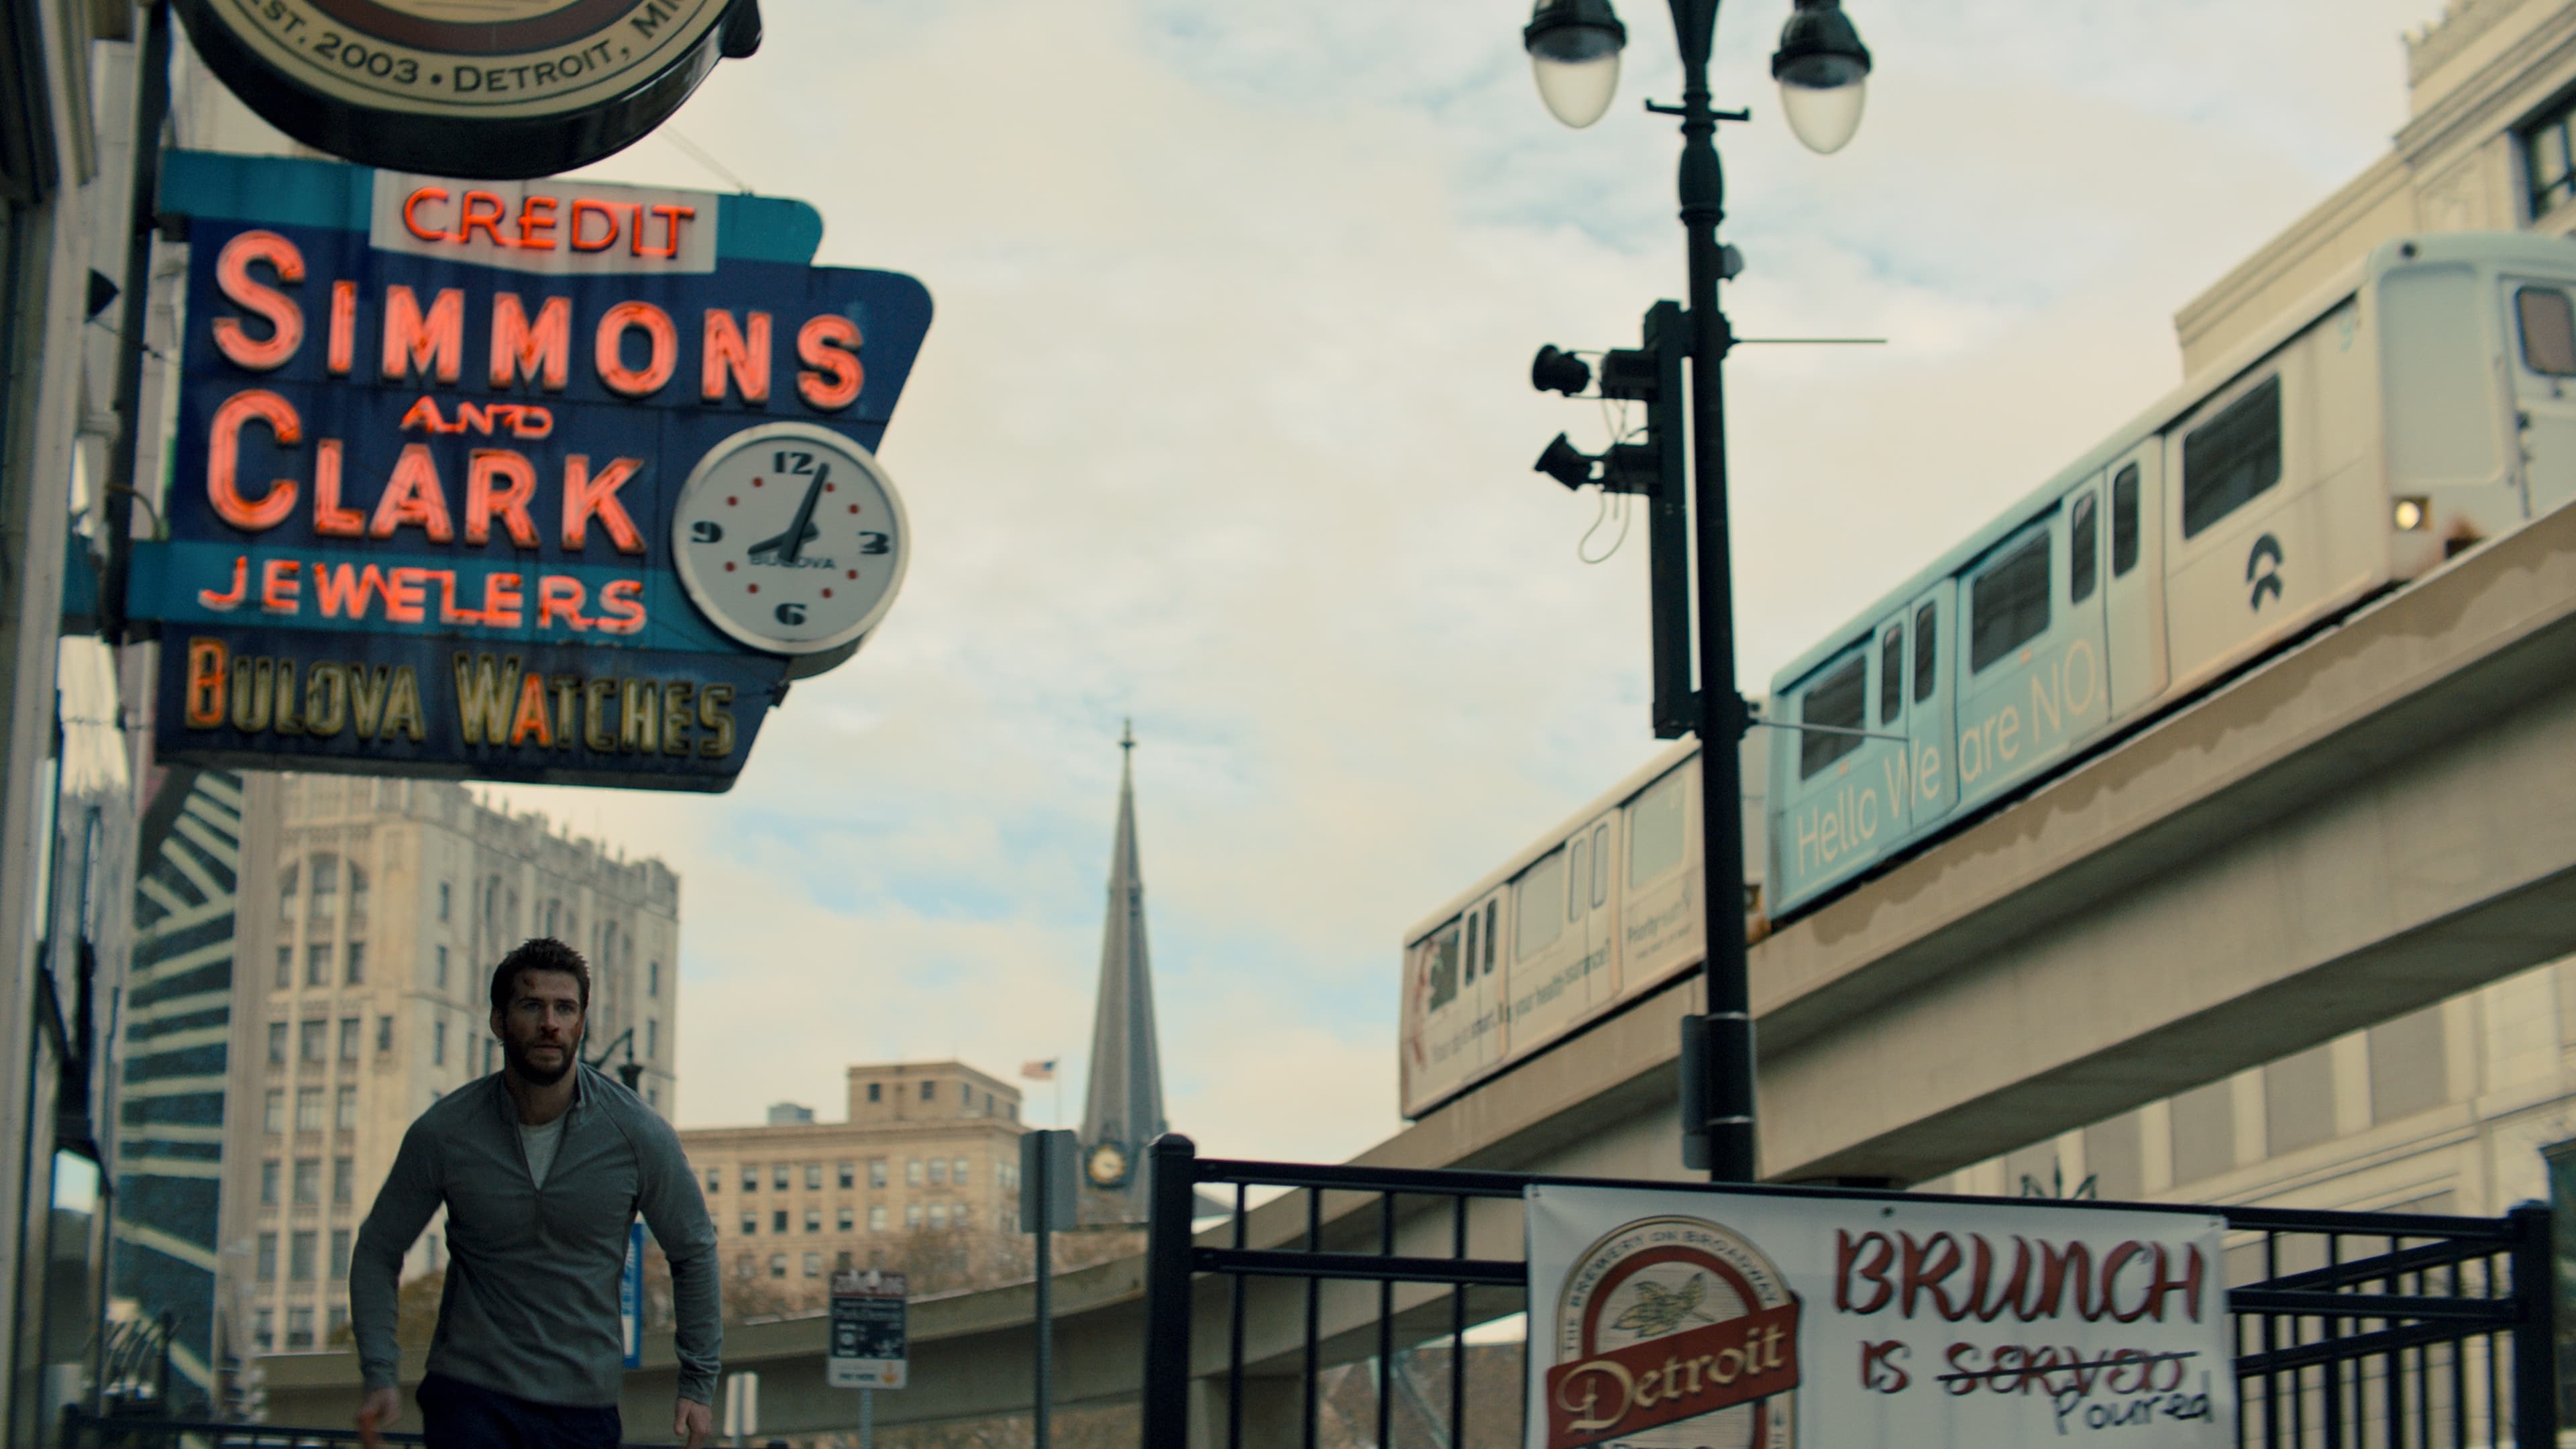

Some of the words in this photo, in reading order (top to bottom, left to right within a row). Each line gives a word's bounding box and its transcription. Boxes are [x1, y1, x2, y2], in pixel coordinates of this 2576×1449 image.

[252, 0, 307, 44] ST.
[313, 32, 420, 85] 2003
[402, 186, 696, 260] CREDIT
[211, 229, 865, 410] SIMMONS
[398, 394, 554, 440] AND
[207, 389, 647, 554] CLARK
[773, 451, 814, 476] 12
[690, 521, 723, 544] 9
[858, 531, 891, 555] 3
[199, 555, 647, 635] JEWELERS
[773, 602, 808, 626] 6
[185, 636, 426, 741] BULOVA
[453, 651, 737, 758] WATCHES
[1796, 782, 1878, 877] Hello
[1883, 736, 1940, 819] We
[1957, 703, 2021, 783] are
[1835, 1228, 2204, 1324] BRUNCH
[1556, 1324, 1786, 1434] Detroit
[1861, 1340, 1913, 1394] IS
[2053, 1370, 2214, 1436] Poured
